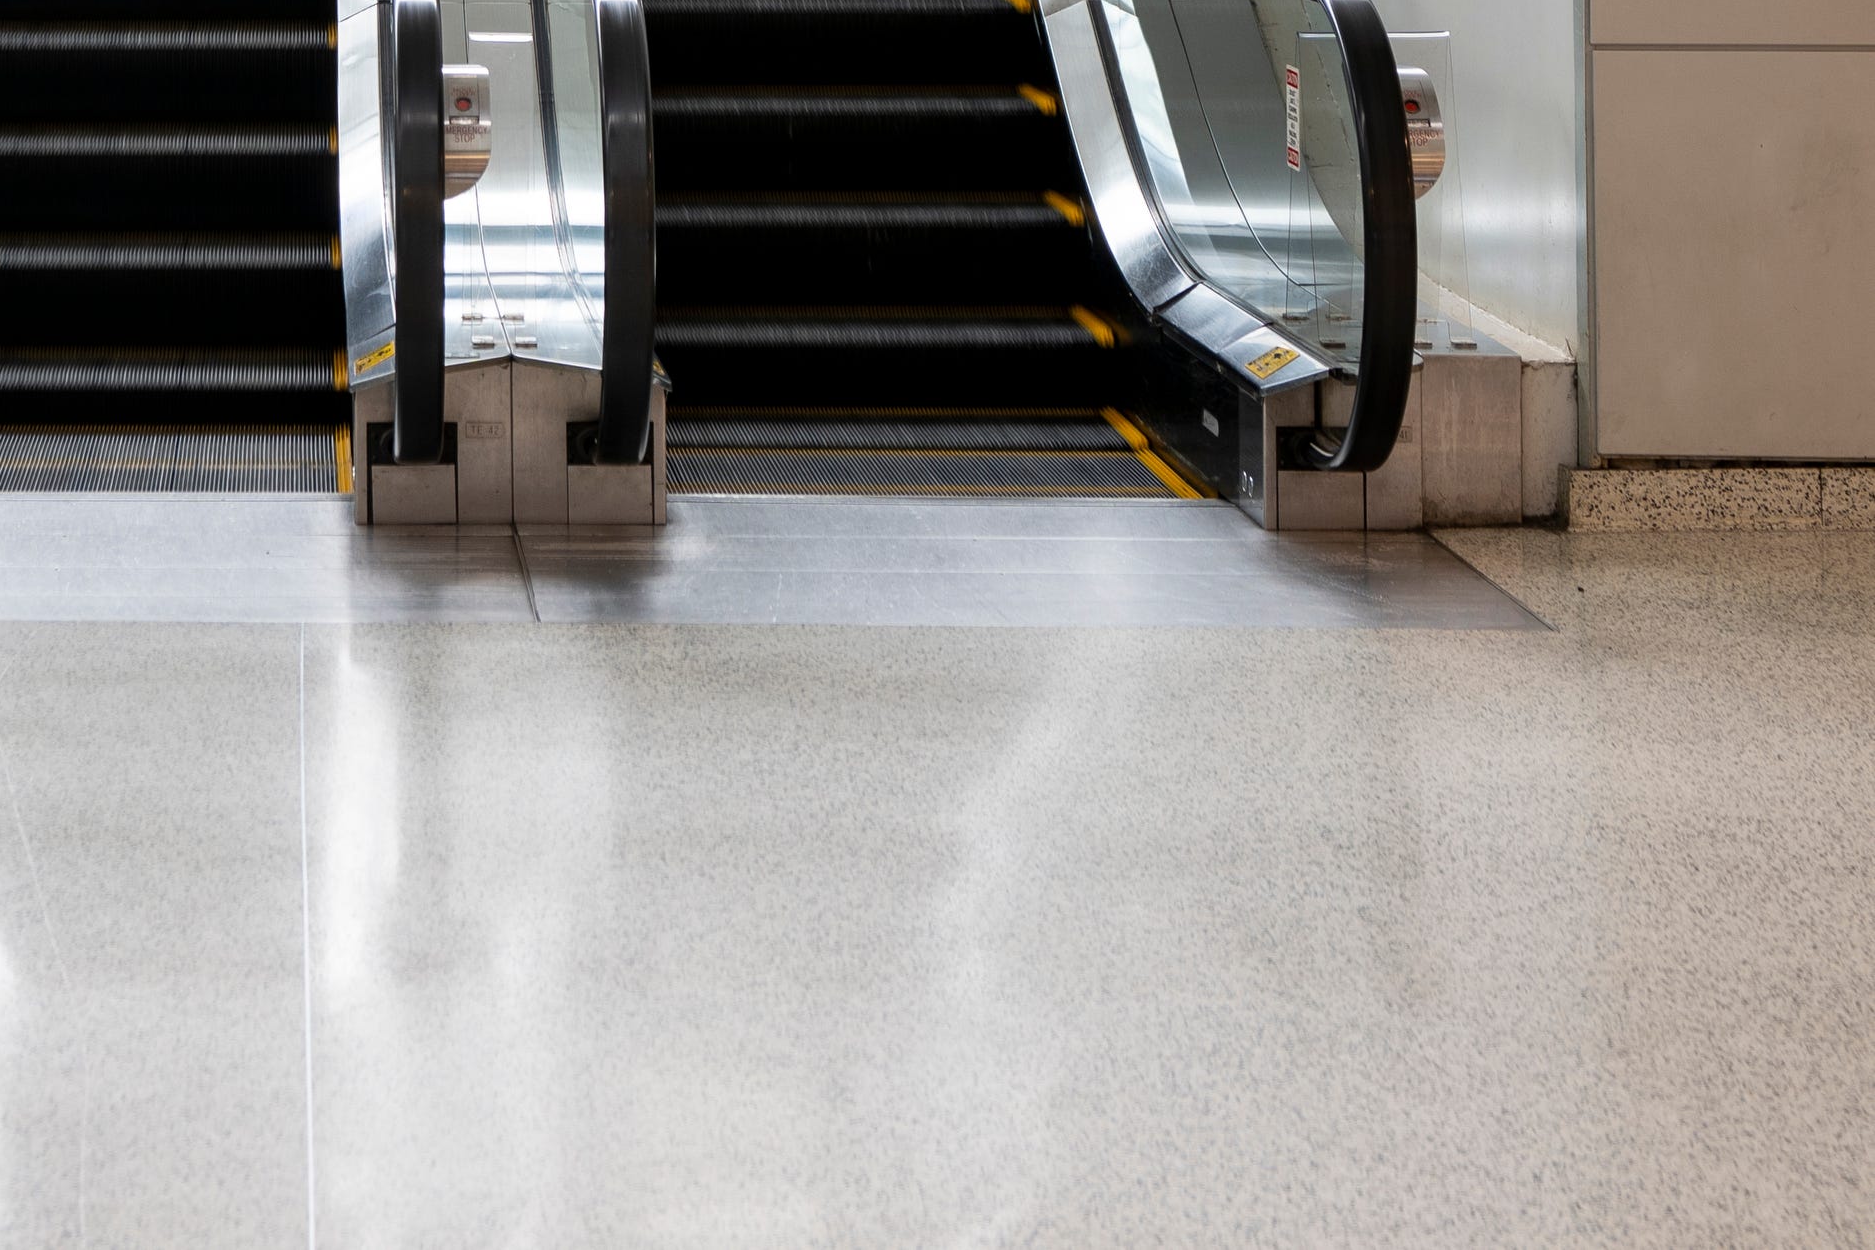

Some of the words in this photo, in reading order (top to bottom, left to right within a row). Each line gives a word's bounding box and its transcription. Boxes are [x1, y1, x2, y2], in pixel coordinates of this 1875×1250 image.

[445, 125, 487, 135] MERGENCY
[454, 134, 476, 143] STOP
[1411, 138, 1428, 147] TOP
